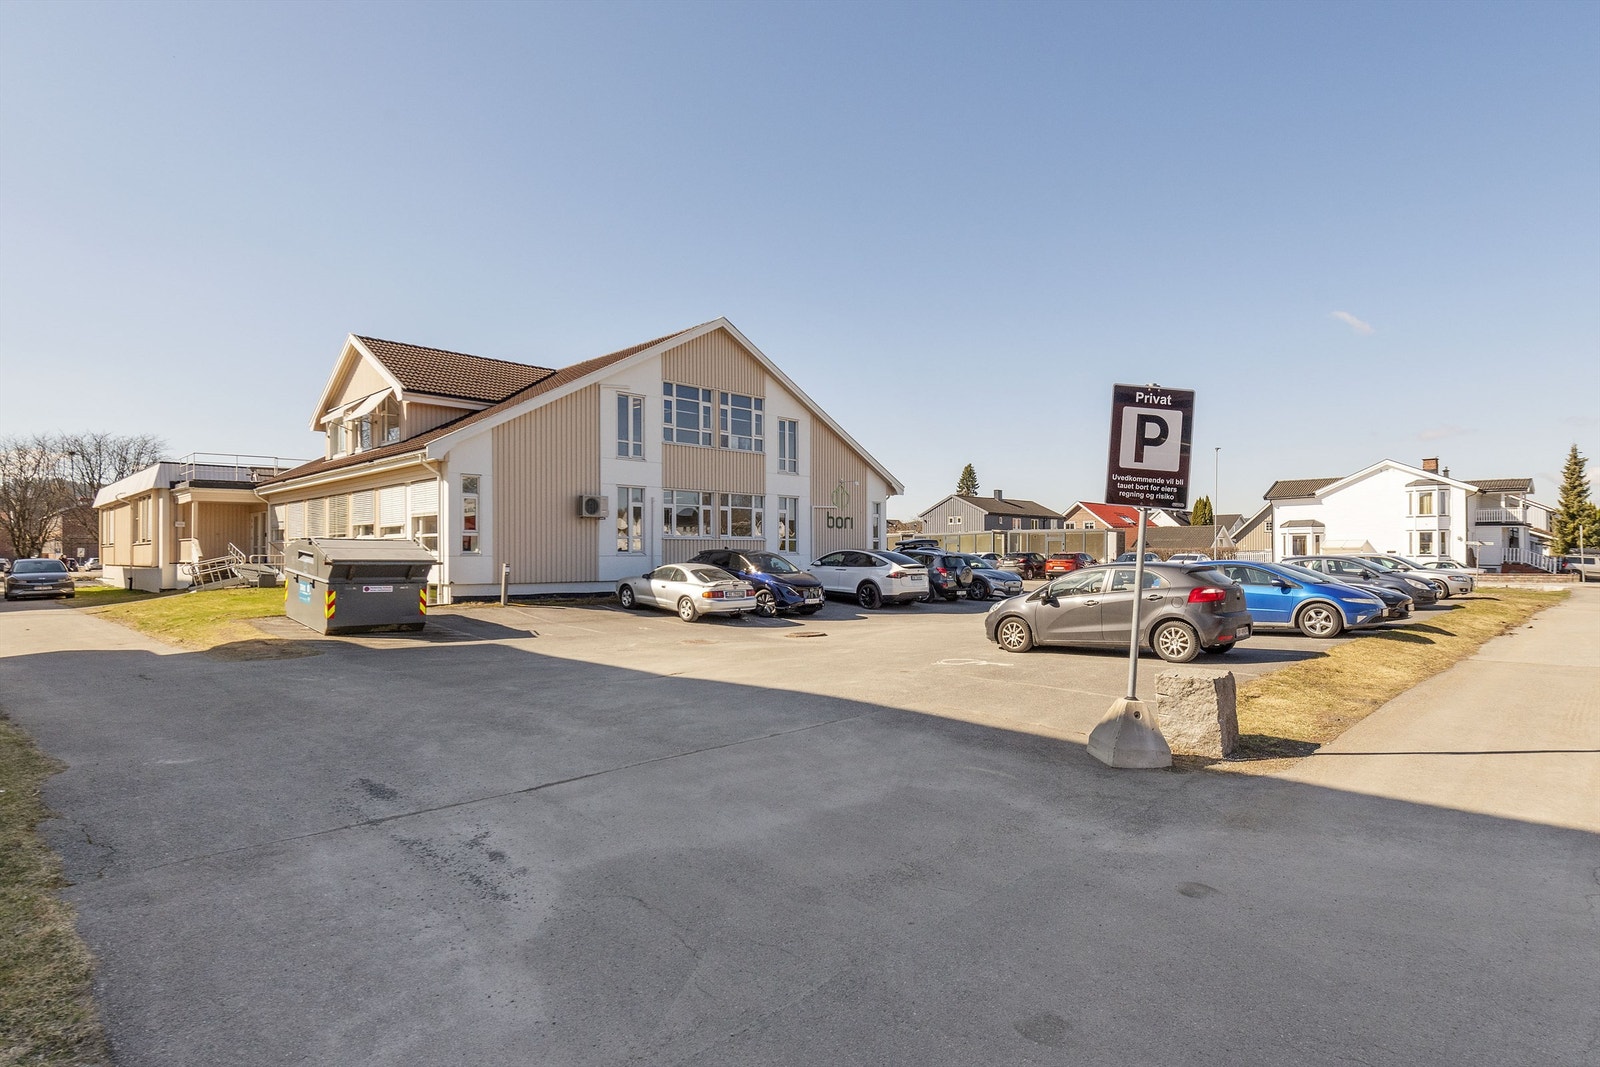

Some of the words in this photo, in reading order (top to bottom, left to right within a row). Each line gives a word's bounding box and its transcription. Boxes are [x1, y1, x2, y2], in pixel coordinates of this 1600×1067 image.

[1135, 391, 1172, 405] Privat
[1134, 413, 1169, 463] P
[1112, 473, 1165, 484] Uvedkommende
[1175, 478, 1184, 486] bli
[1117, 482, 1134, 490] tauet
[1135, 483, 1149, 491] bort
[1161, 485, 1178, 493] eiers
[1119, 491, 1145, 499] regning
[1155, 492, 1175, 501] risiko
